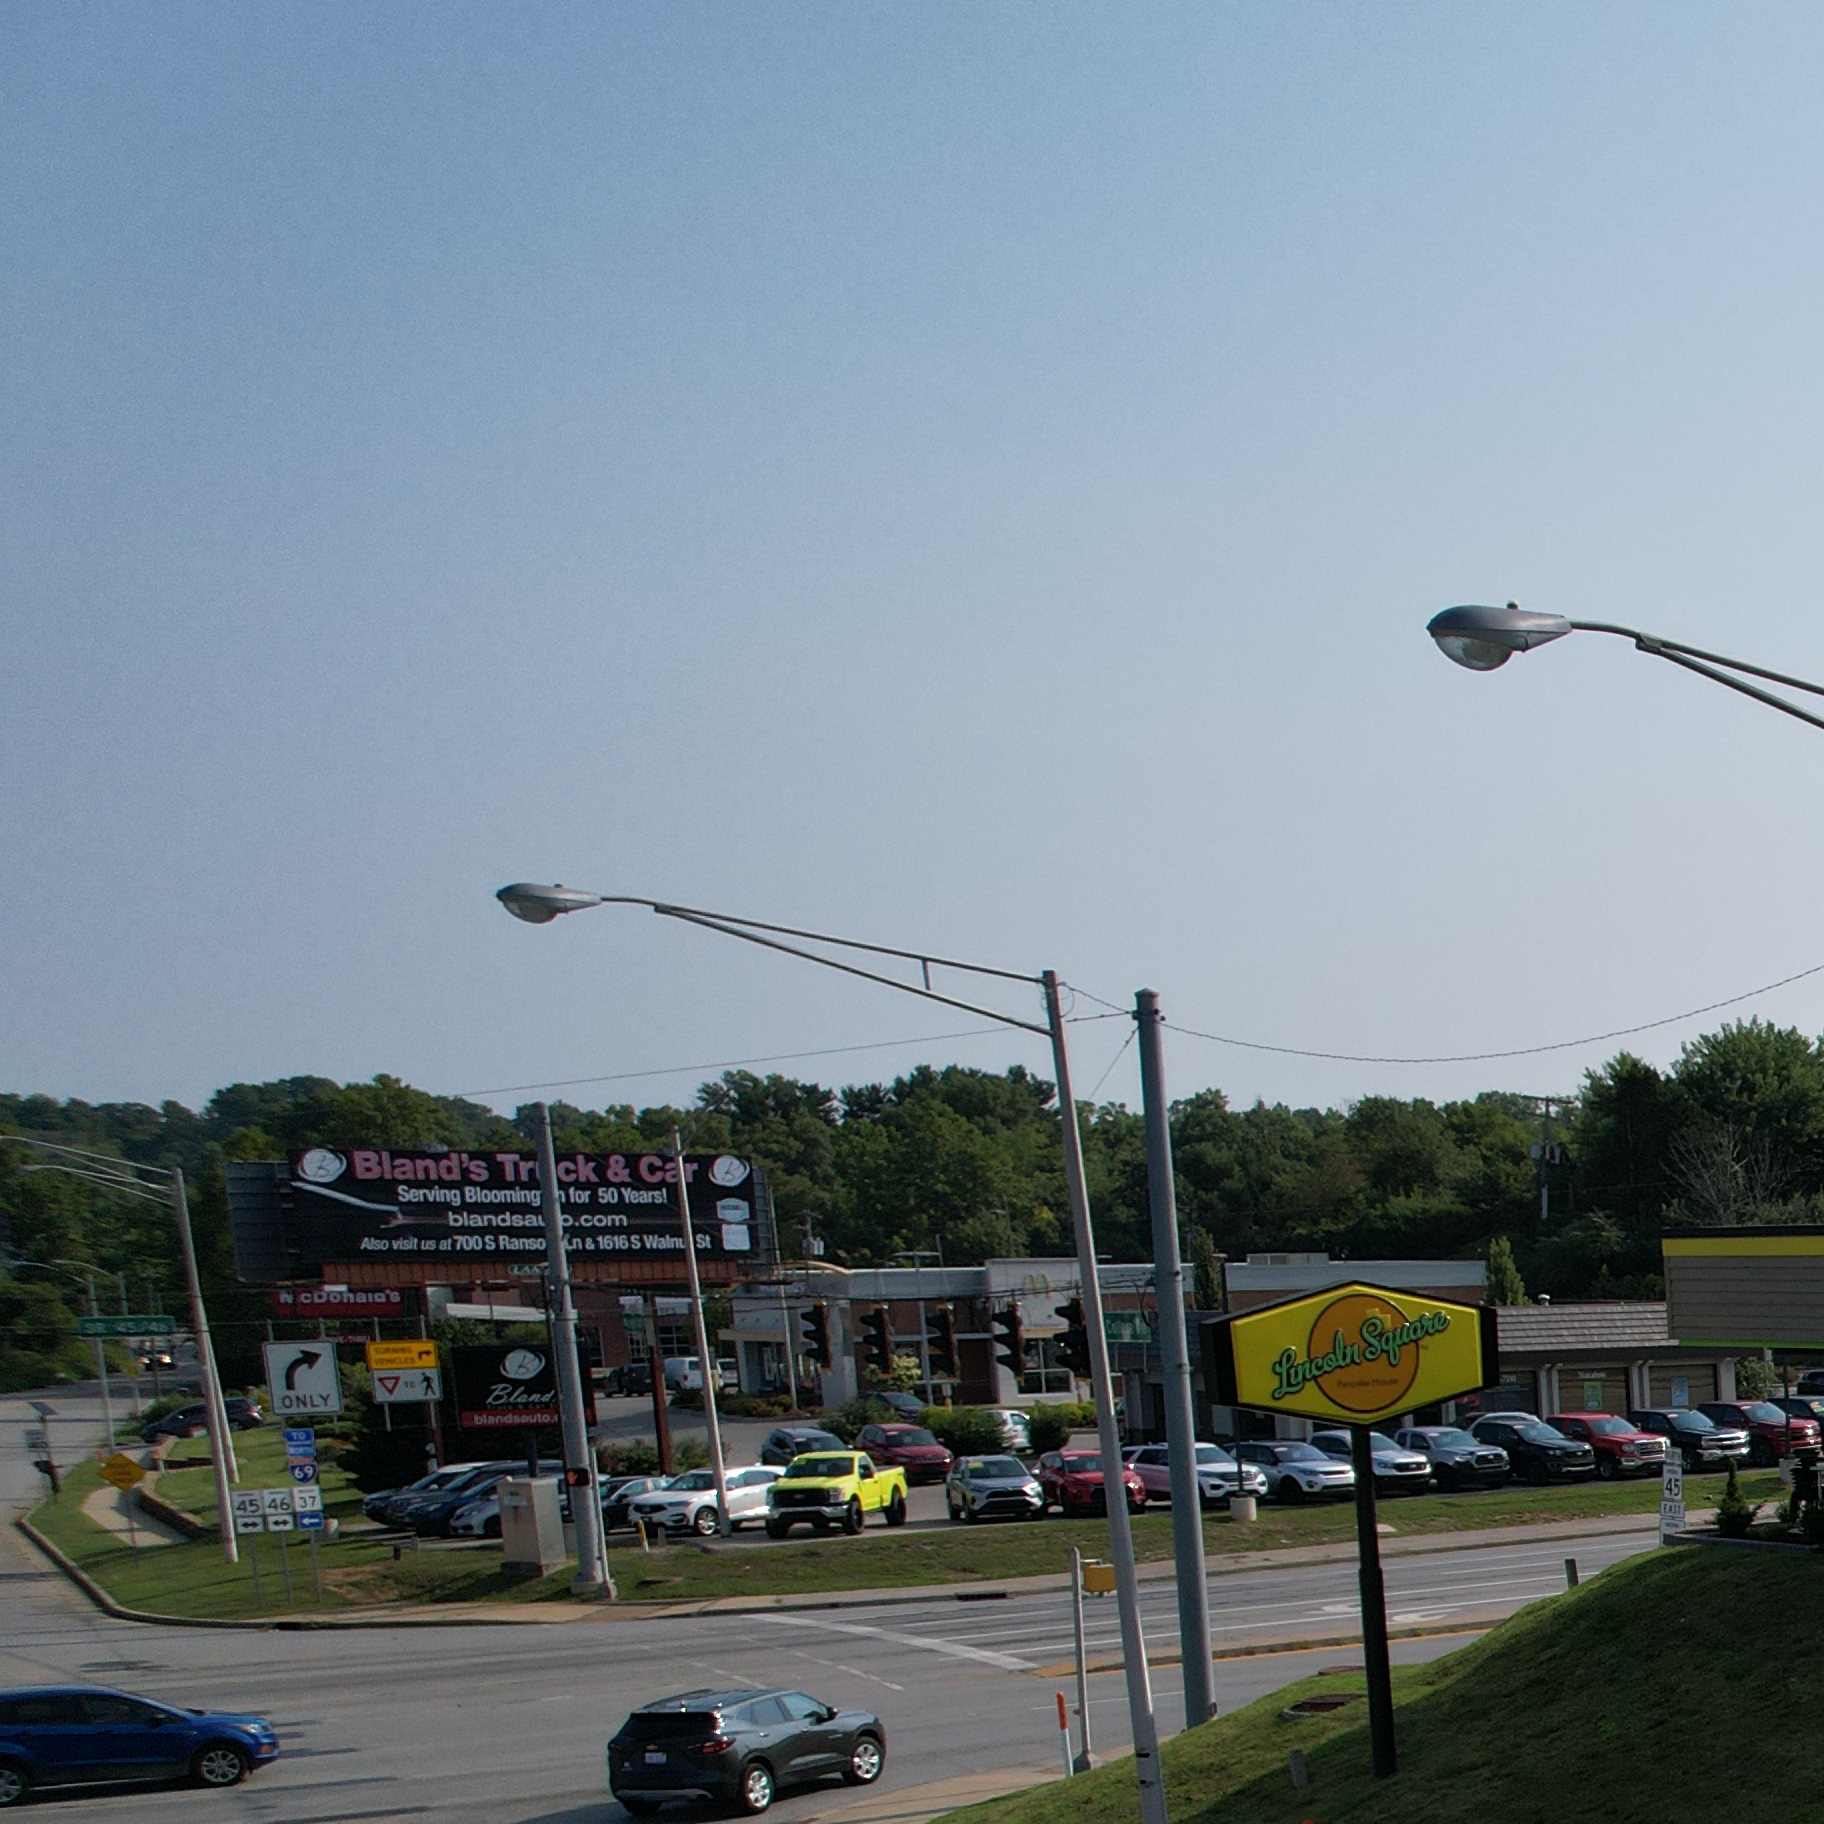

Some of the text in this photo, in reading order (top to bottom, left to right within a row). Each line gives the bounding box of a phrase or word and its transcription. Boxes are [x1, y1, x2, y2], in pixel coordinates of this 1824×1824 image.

[354, 1150, 490, 1182] Bland's
[606, 1154, 632, 1182] &
[639, 1155, 699, 1183] Car
[398, 1185, 668, 1208] Serving Bloomingn for 50 Years!
[360, 1237, 388, 1250] Also
[392, 1237, 418, 1250] visit
[421, 1240, 436, 1250] us
[439, 1238, 452, 1250] at
[453, 1236, 483, 1250] 700
[485, 1236, 494, 1250] S
[499, 1236, 546, 1250] Ranso
[585, 1236, 595, 1250] &
[598, 1235, 629, 1250] 1616
[631, 1235, 641, 1250] S
[643, 1235, 687, 1250] Walnu
[696, 1234, 712, 1249] St
[1272, 1310, 1451, 1400] Lincoln Square
[404, 1380, 415, 1389] TO
[485, 1383, 556, 1405] Bland
[282, 1393, 331, 1410] ONLY
[474, 1412, 559, 1425] blandsauto.
[291, 1431, 306, 1440] TO
[294, 1465, 314, 1479] 69
[1665, 1477, 1680, 1497] 45
[236, 1499, 260, 1513] 45
[267, 1497, 291, 1511] 46
[299, 1496, 317, 1509] 37
[1663, 1503, 1682, 1515] EAST
